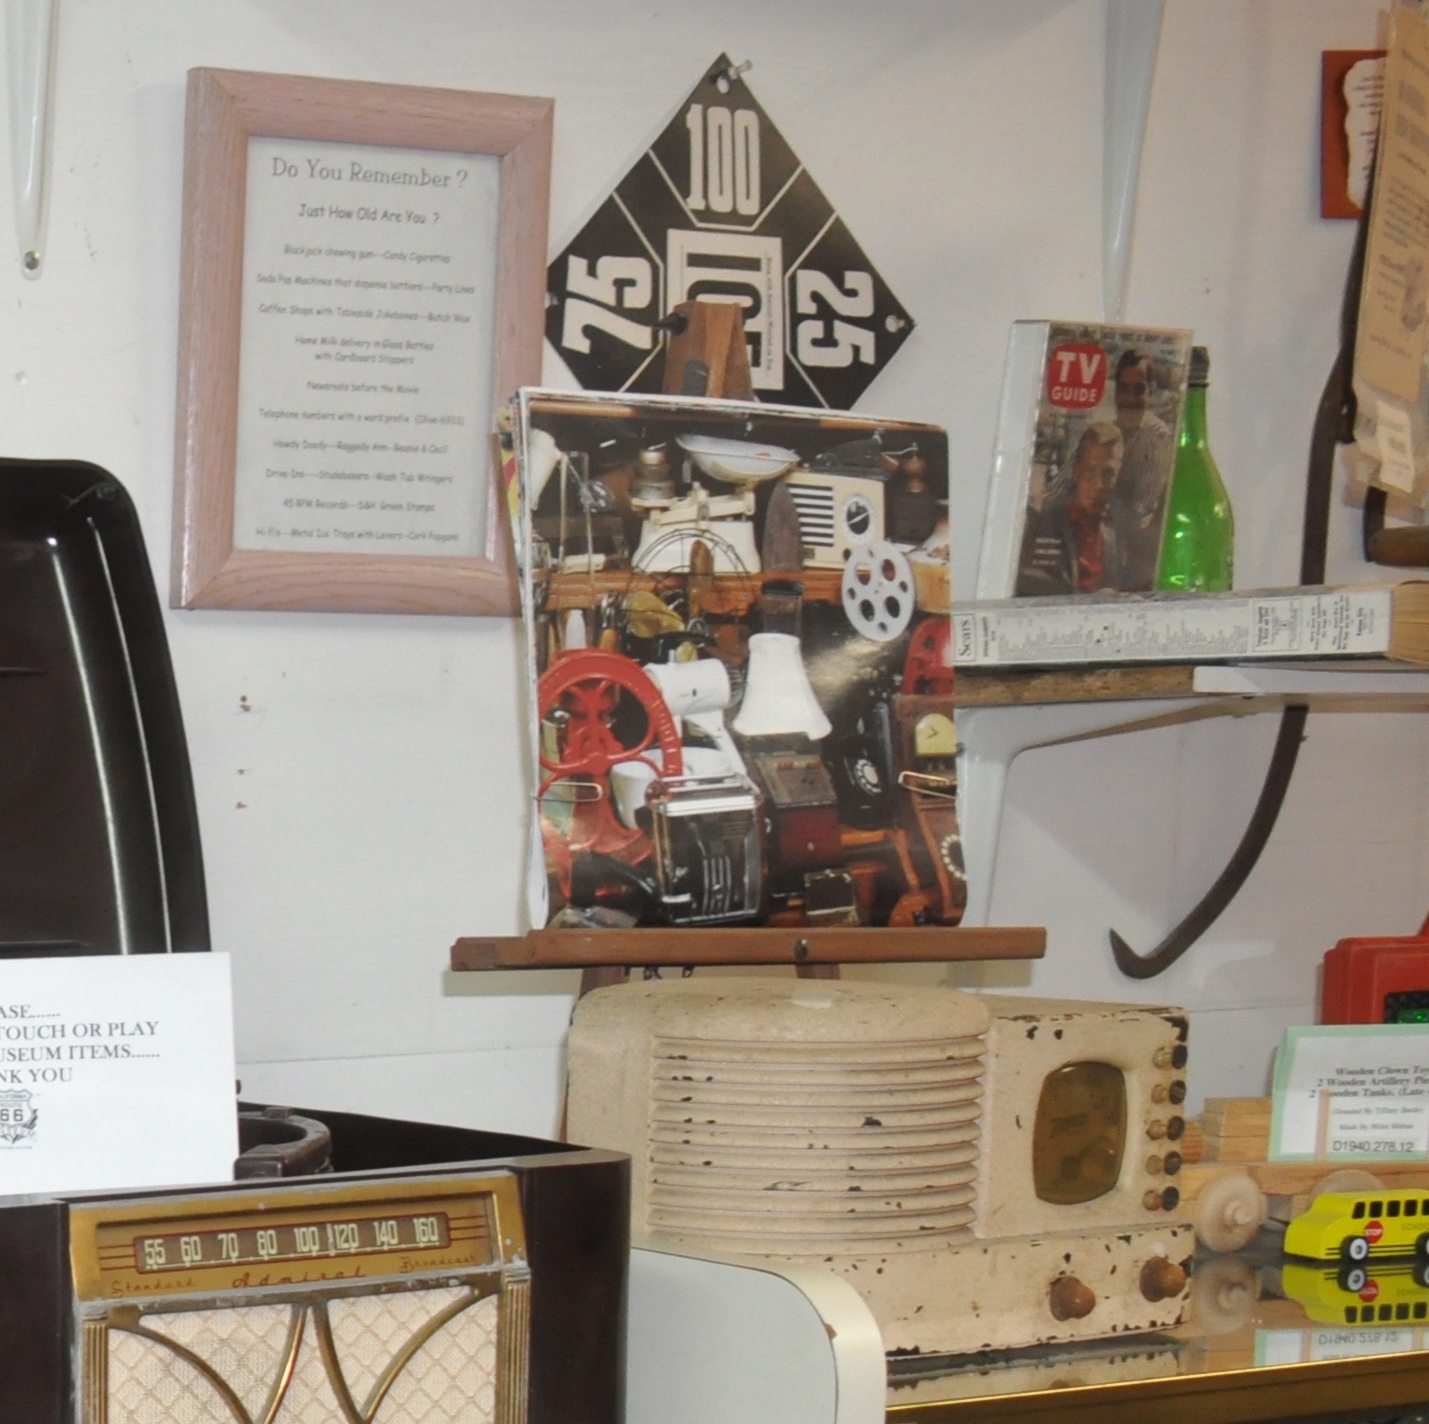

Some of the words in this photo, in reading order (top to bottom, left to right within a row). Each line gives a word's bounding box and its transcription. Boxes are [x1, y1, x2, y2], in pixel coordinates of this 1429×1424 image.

[272, 157, 298, 178] Do
[306, 158, 342, 181] You
[349, 162, 450, 188] Remember
[457, 169, 468, 188] ?
[684, 103, 760, 216] 100
[298, 203, 325, 218] Just
[328, 206, 354, 220] How
[356, 207, 377, 221] Old
[380, 209, 402, 223] Are
[405, 211, 426, 224] You
[561, 254, 653, 354] 75
[795, 269, 876, 368] 25
[1056, 351, 1101, 384] TV
[1052, 386, 1097, 402] GUIDE
[957, 614, 974, 658] Sears
[72, 1023, 103, 1039] OR
[107, 1020, 159, 1037] PLAY
[27, 1067, 74, 1083] YOU
[1327, 1078, 1366, 1086] Wooden
[1378, 1066, 1409, 1074] Clown
[0, 1108, 25, 1123] 66
[145, 1238, 165, 1265] 55
[180, 1236, 202, 1262] 60
[217, 1233, 238, 1258] 70
[257, 1230, 278, 1255] 80
[293, 1226, 320, 1253] 100
[332, 1223, 359, 1249] 120
[373, 1220, 398, 1246] 140
[412, 1217, 439, 1243] 160
[110, 1278, 195, 1297] Standard
[231, 1264, 367, 1289] Admiral
[399, 1253, 479, 1274] Broadcast
